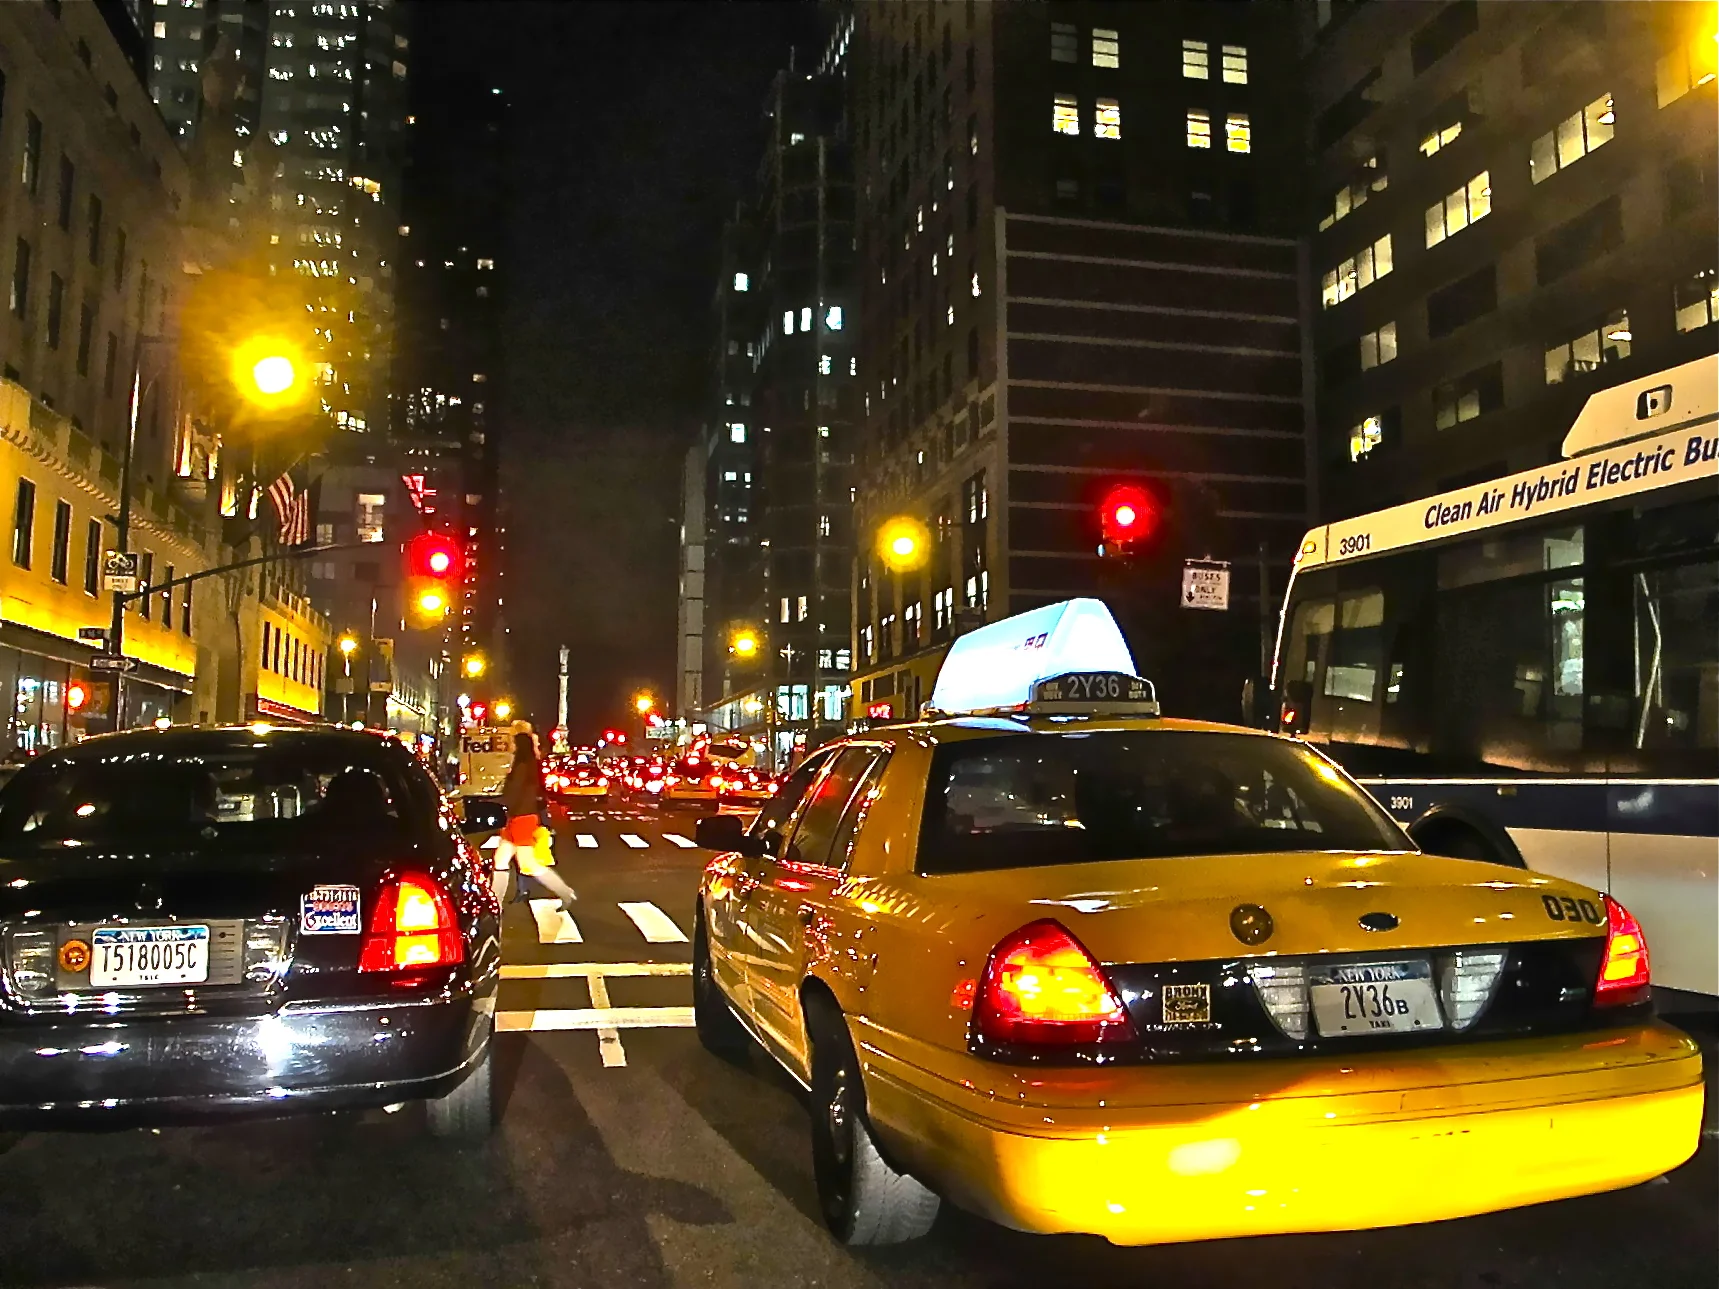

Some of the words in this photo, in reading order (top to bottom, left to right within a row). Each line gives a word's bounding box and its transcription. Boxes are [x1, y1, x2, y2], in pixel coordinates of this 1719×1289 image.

[1424, 501, 1473, 529] Clean
[1475, 488, 1506, 517] Air
[1510, 466, 1580, 511] Hybrid
[1586, 445, 1676, 490] Electric
[1683, 436, 1719, 467] Bu
[1340, 533, 1371, 556] 3901
[1067, 674, 1120, 699] 2Y36
[1390, 796, 1413, 810] 3901
[1541, 894, 1601, 925] 030
[101, 942, 198, 973] T518005C
[1337, 967, 1365, 982] NEW
[1366, 965, 1401, 981] YORK
[1340, 984, 1410, 1019] 2Y36B
[1368, 1020, 1392, 1029] TAXI
